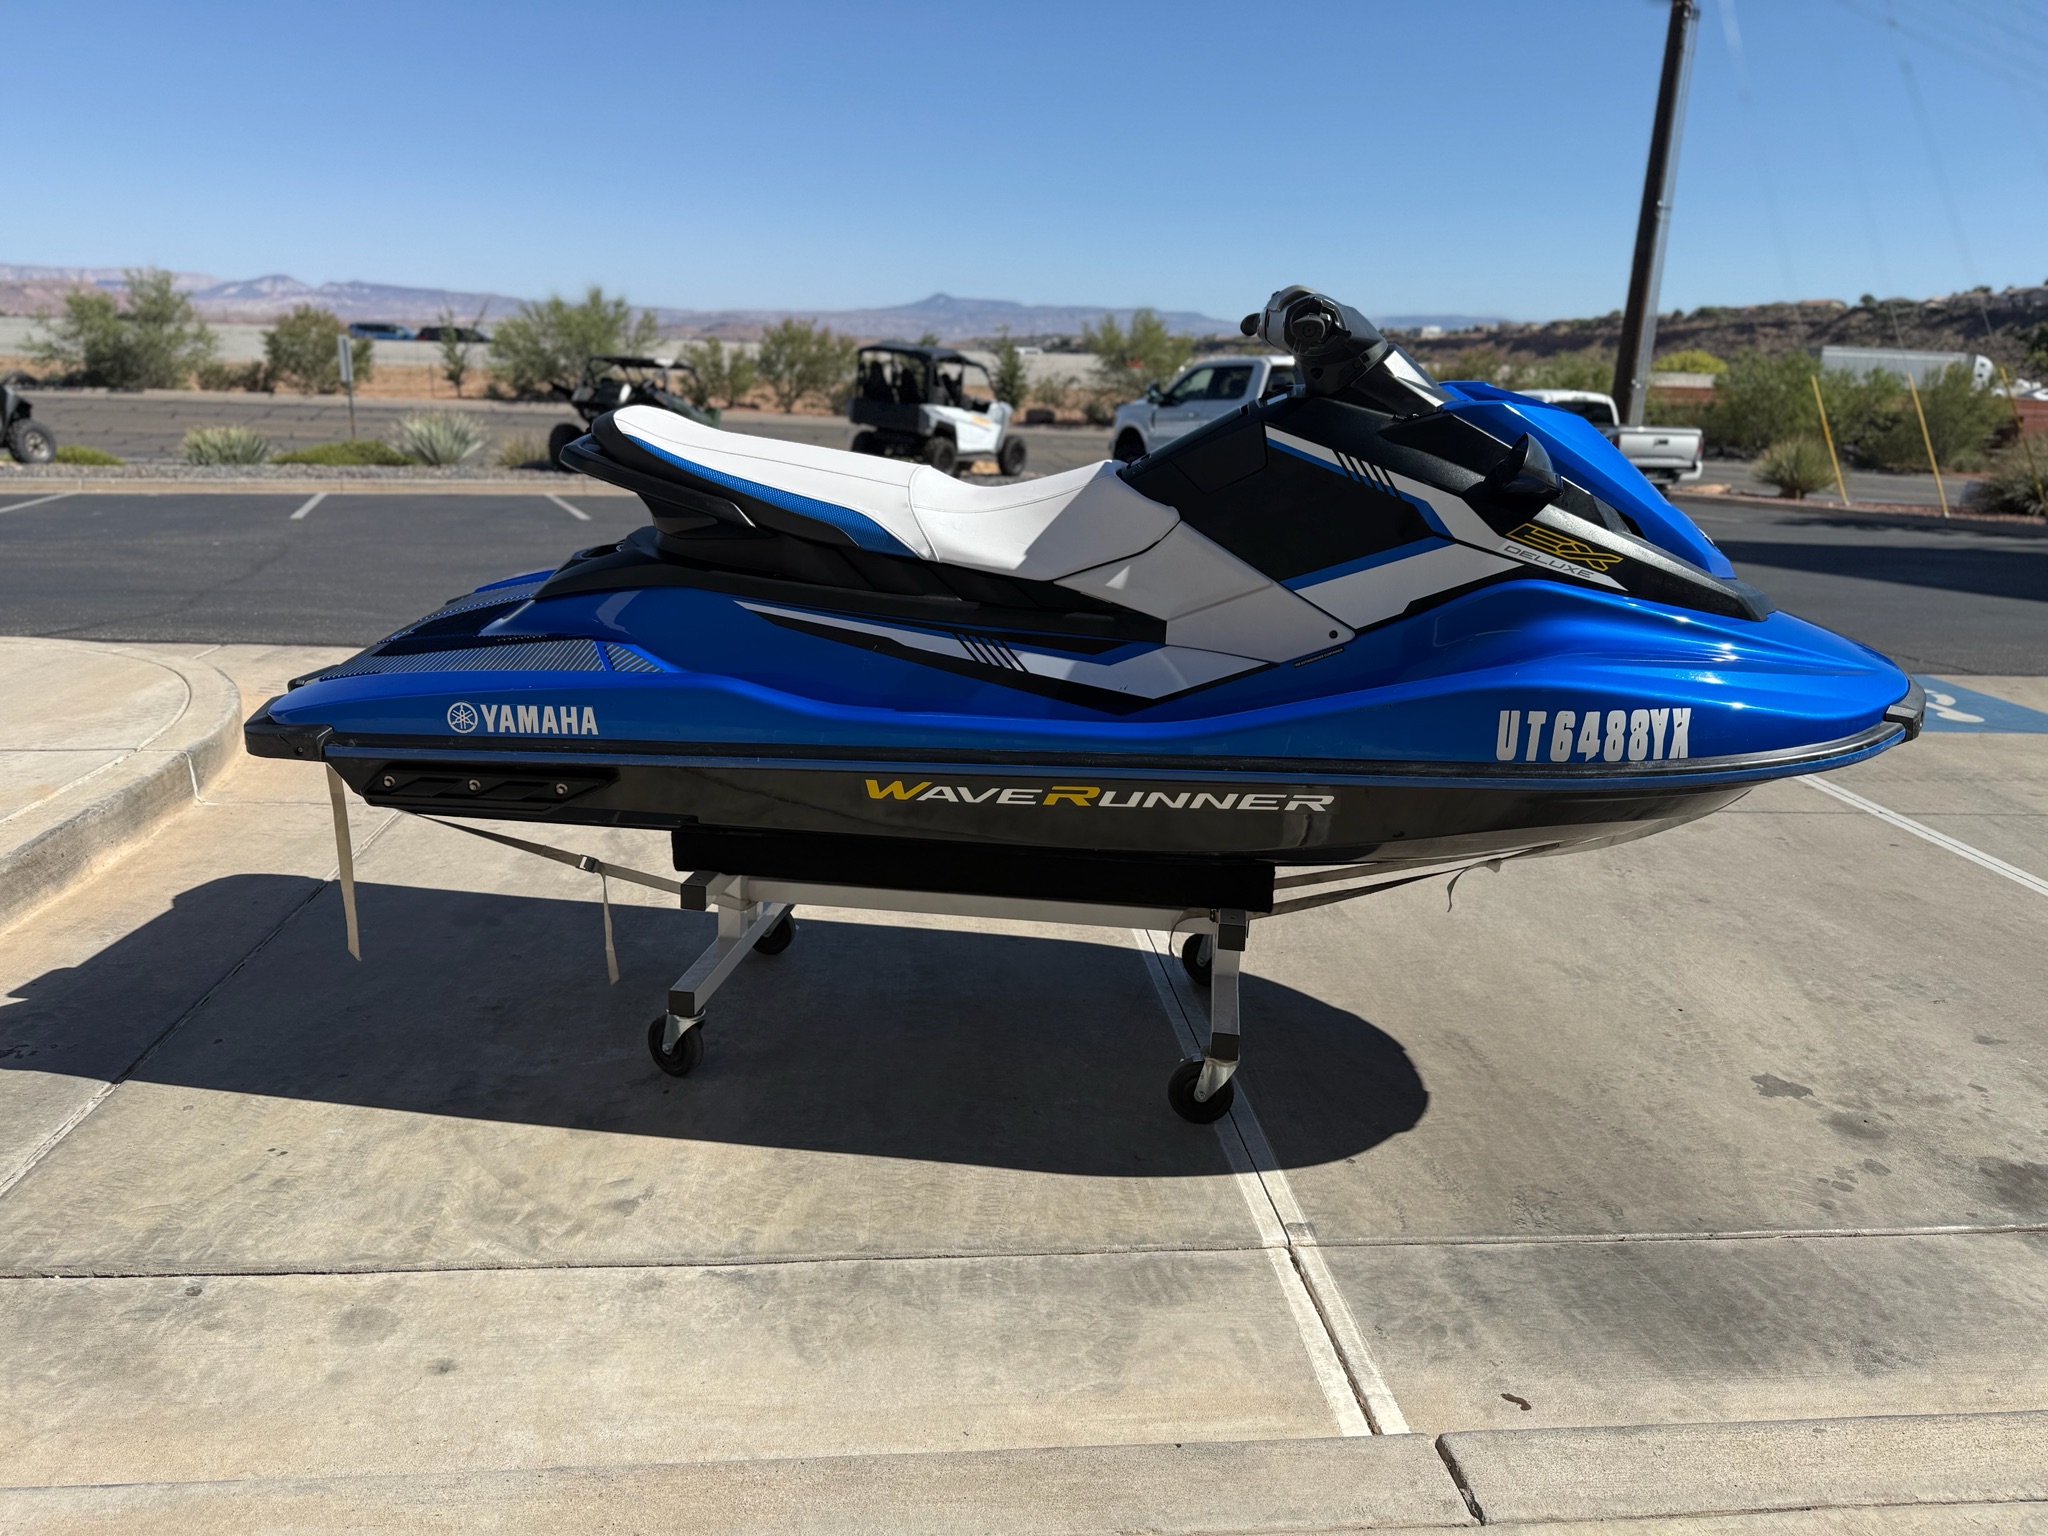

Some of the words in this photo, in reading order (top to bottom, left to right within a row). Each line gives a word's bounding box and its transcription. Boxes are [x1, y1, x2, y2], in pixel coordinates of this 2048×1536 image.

[1504, 545, 1594, 578] DELUXE
[1505, 523, 1623, 572] EX
[480, 704, 599, 735] YAMAHA
